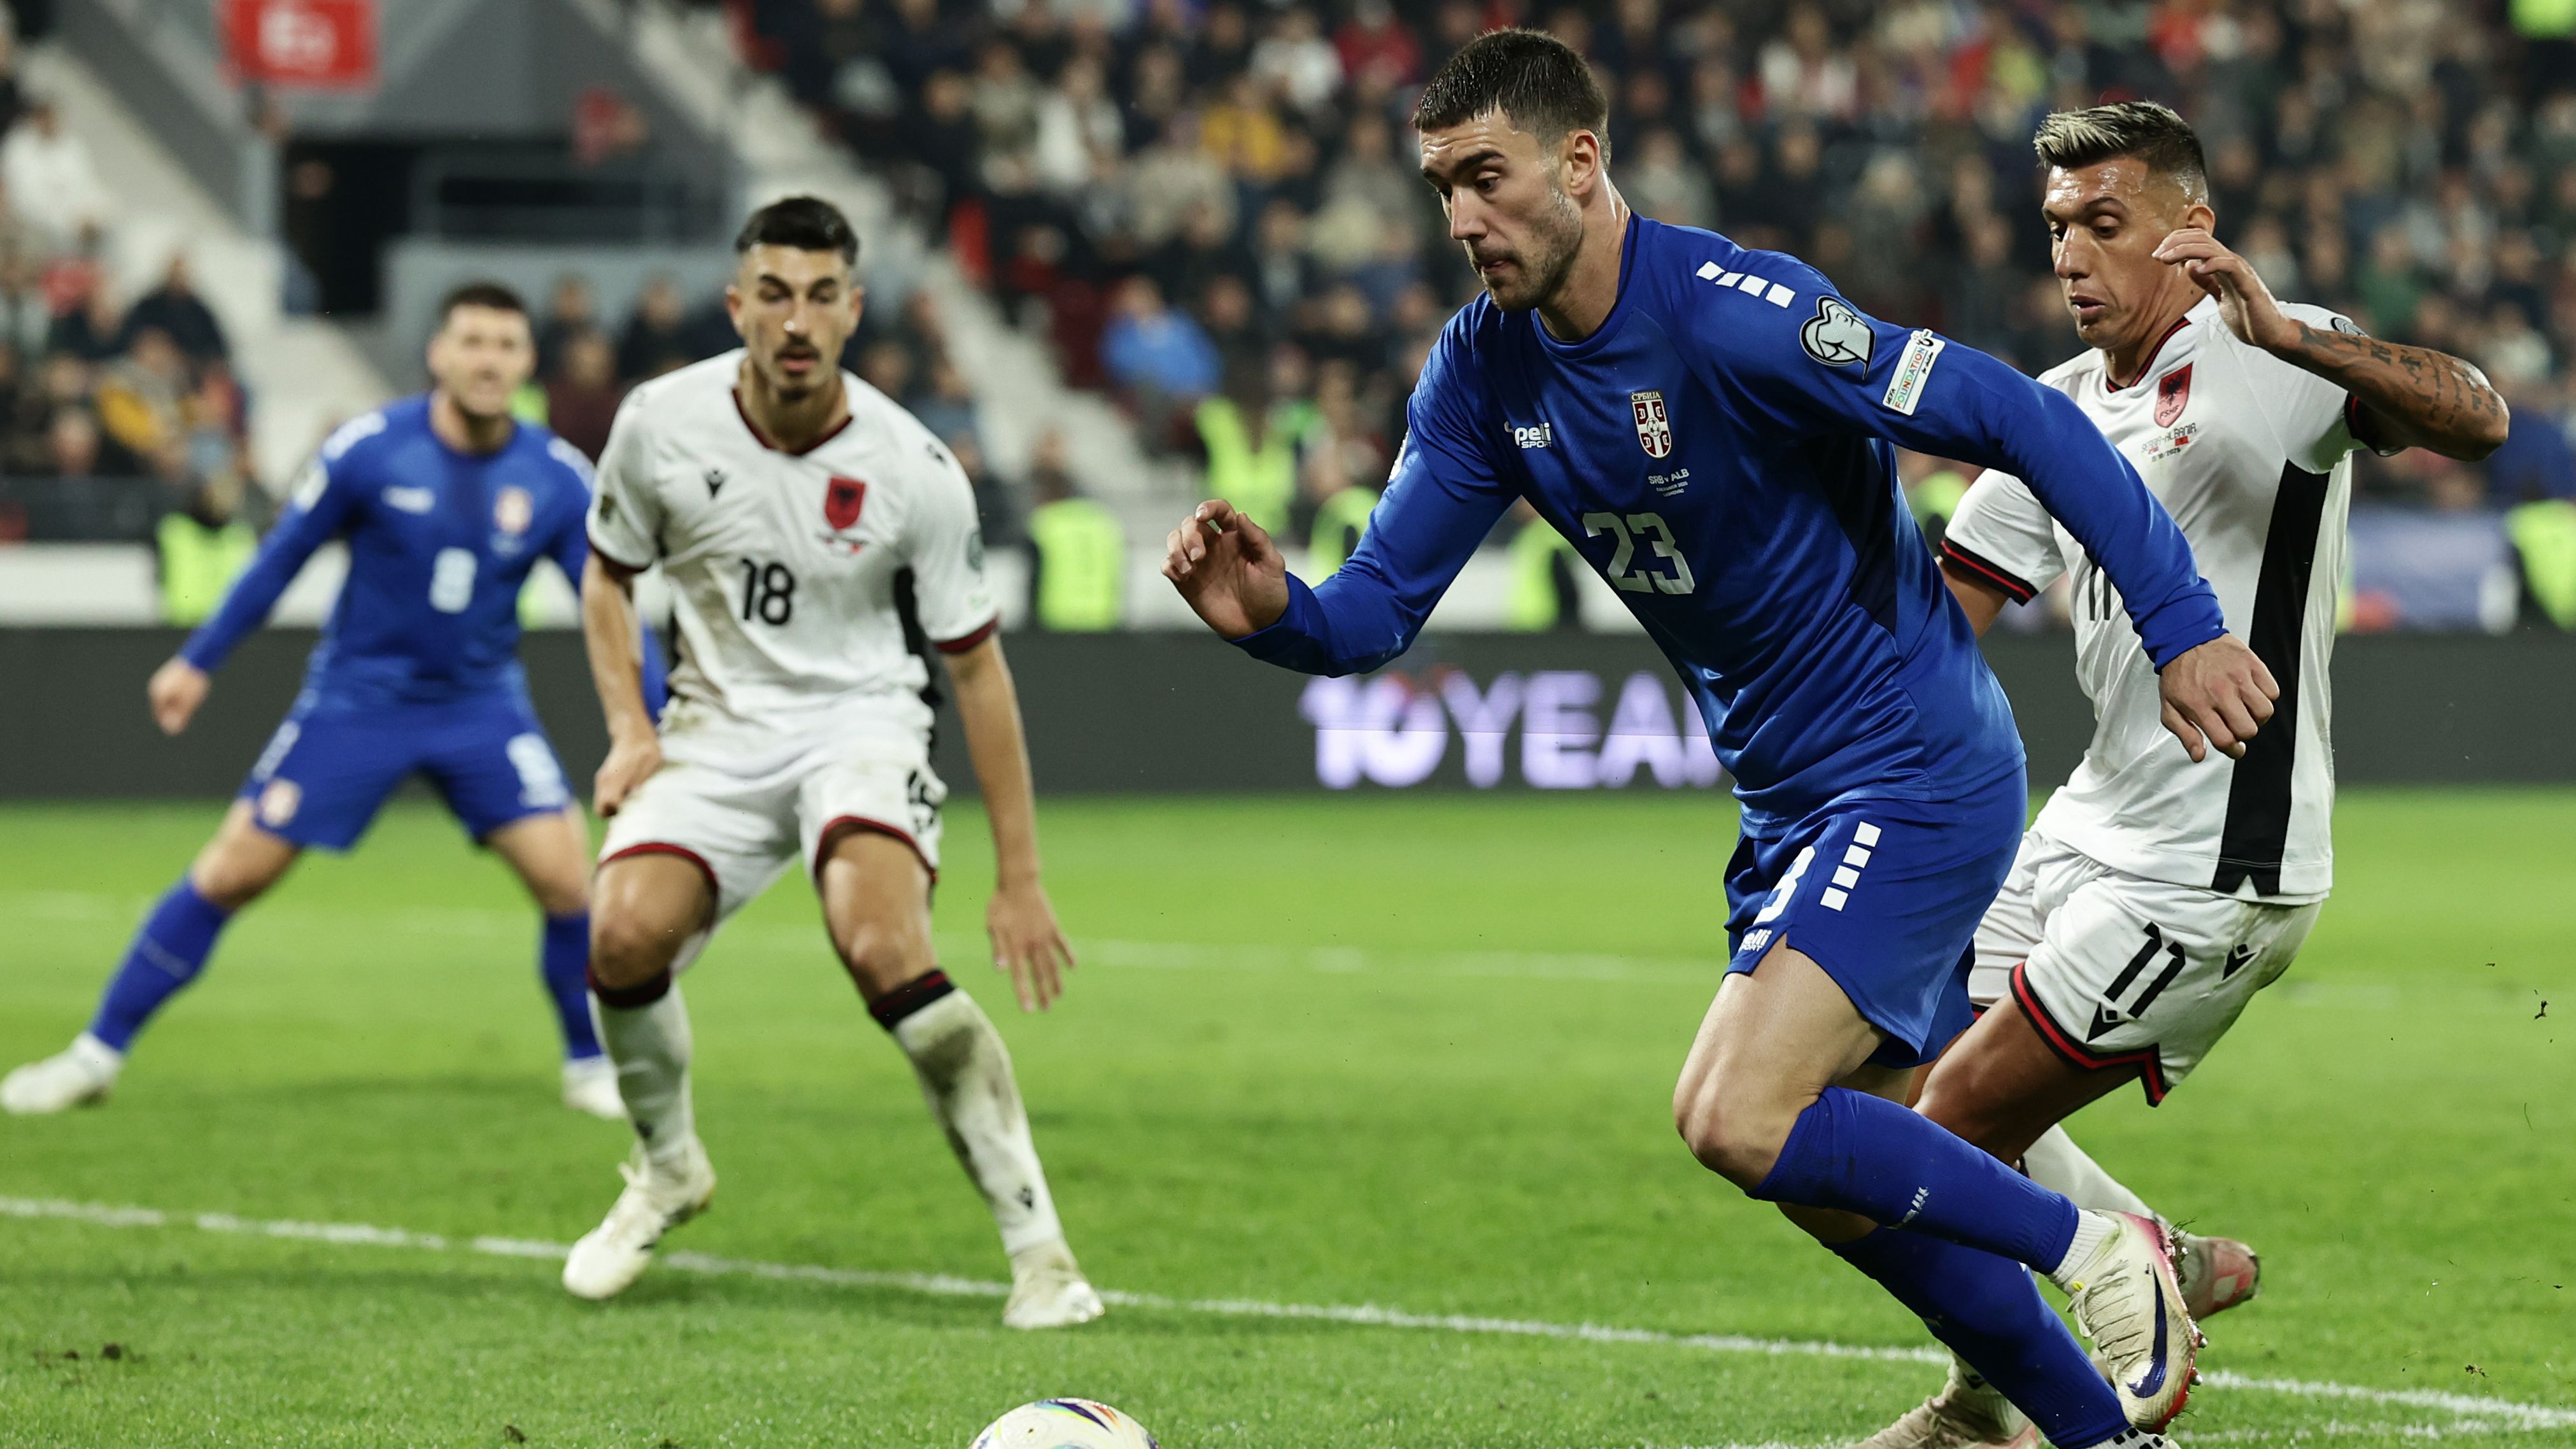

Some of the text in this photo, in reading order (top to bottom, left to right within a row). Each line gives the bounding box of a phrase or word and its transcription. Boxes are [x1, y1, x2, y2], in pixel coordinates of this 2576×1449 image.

[1631, 392, 1661, 401] СРБИЈА
[1886, 388, 1896, 404] UEFA
[1895, 347, 1925, 409] FOUNDATION
[1648, 475, 1664, 484] SRB
[1671, 468, 1690, 481] ALB
[428, 546, 478, 614] 8
[1582, 512, 1695, 595] 23
[740, 558, 795, 626] 18
[2103, 921, 2186, 1019] 11
